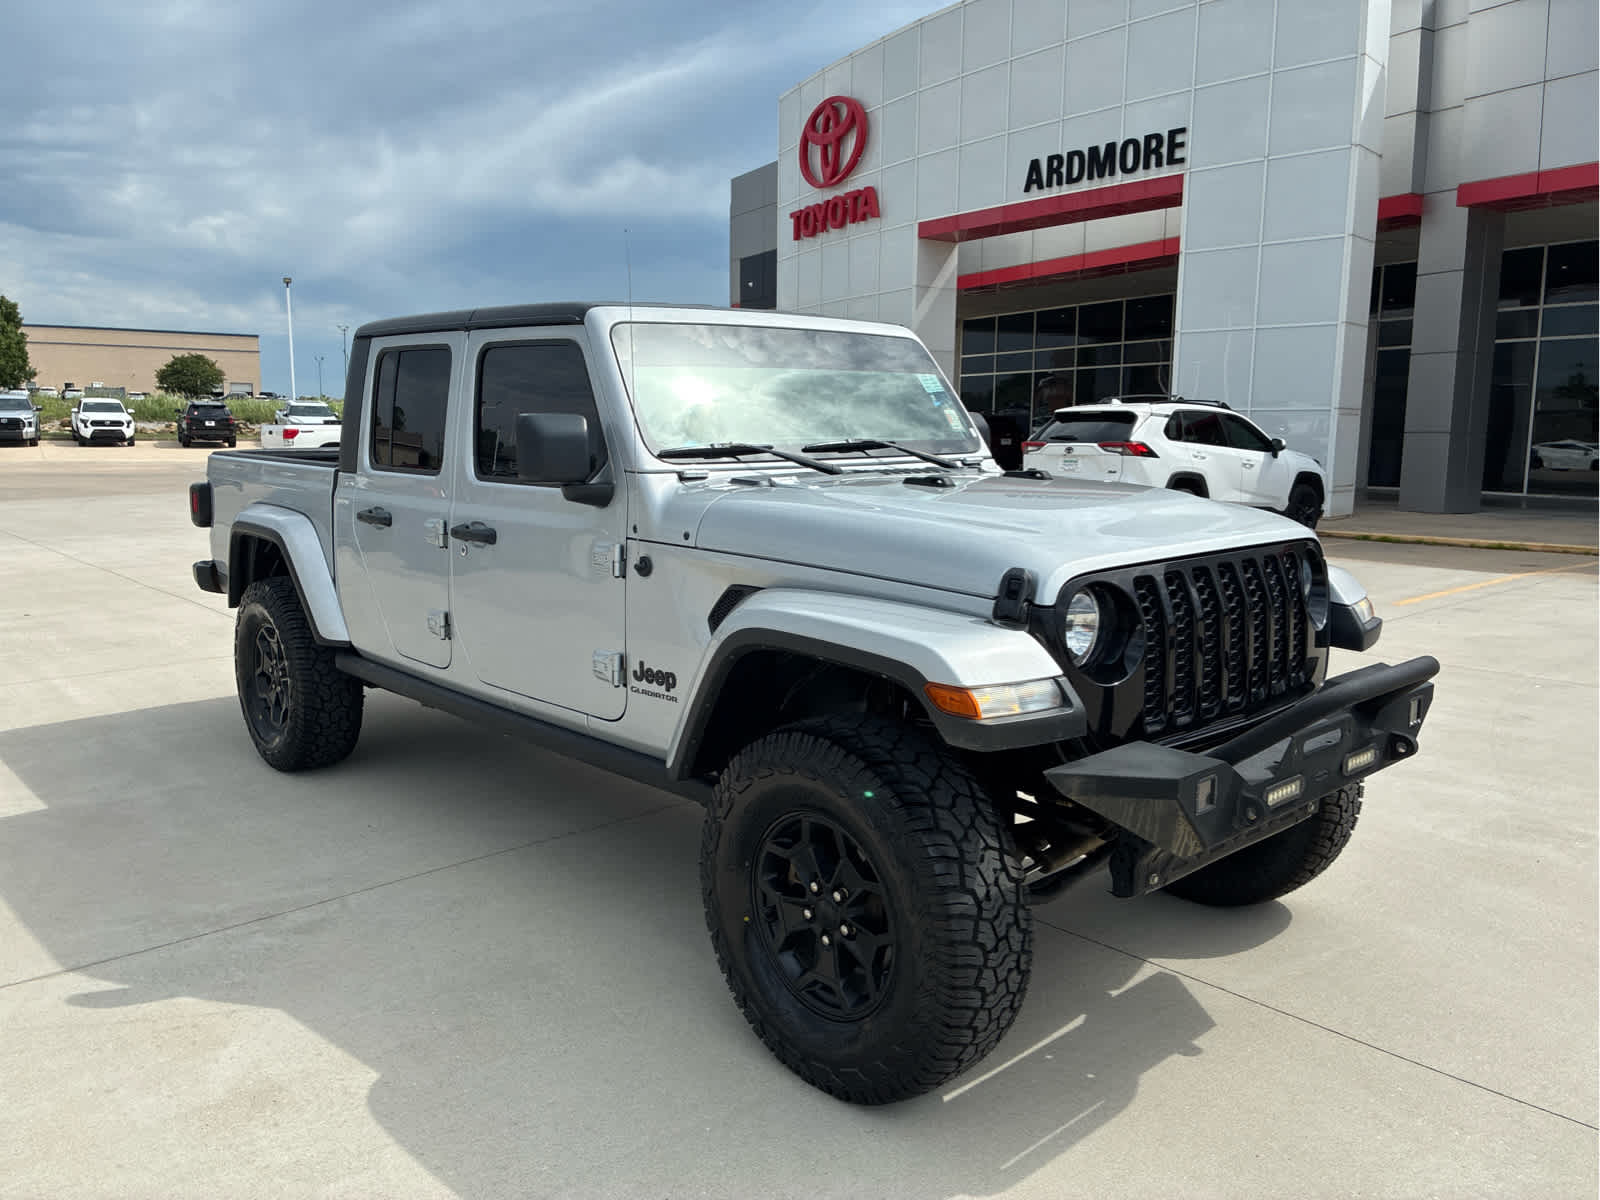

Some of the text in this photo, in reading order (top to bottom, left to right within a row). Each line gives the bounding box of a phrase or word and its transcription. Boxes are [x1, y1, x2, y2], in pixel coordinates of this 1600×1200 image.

[1023, 127, 1187, 193] ARDMORE
[789, 186, 880, 241] TOYOTA
[630, 686, 679, 703] GLADIATOR
[632, 660, 677, 692] Jeep
